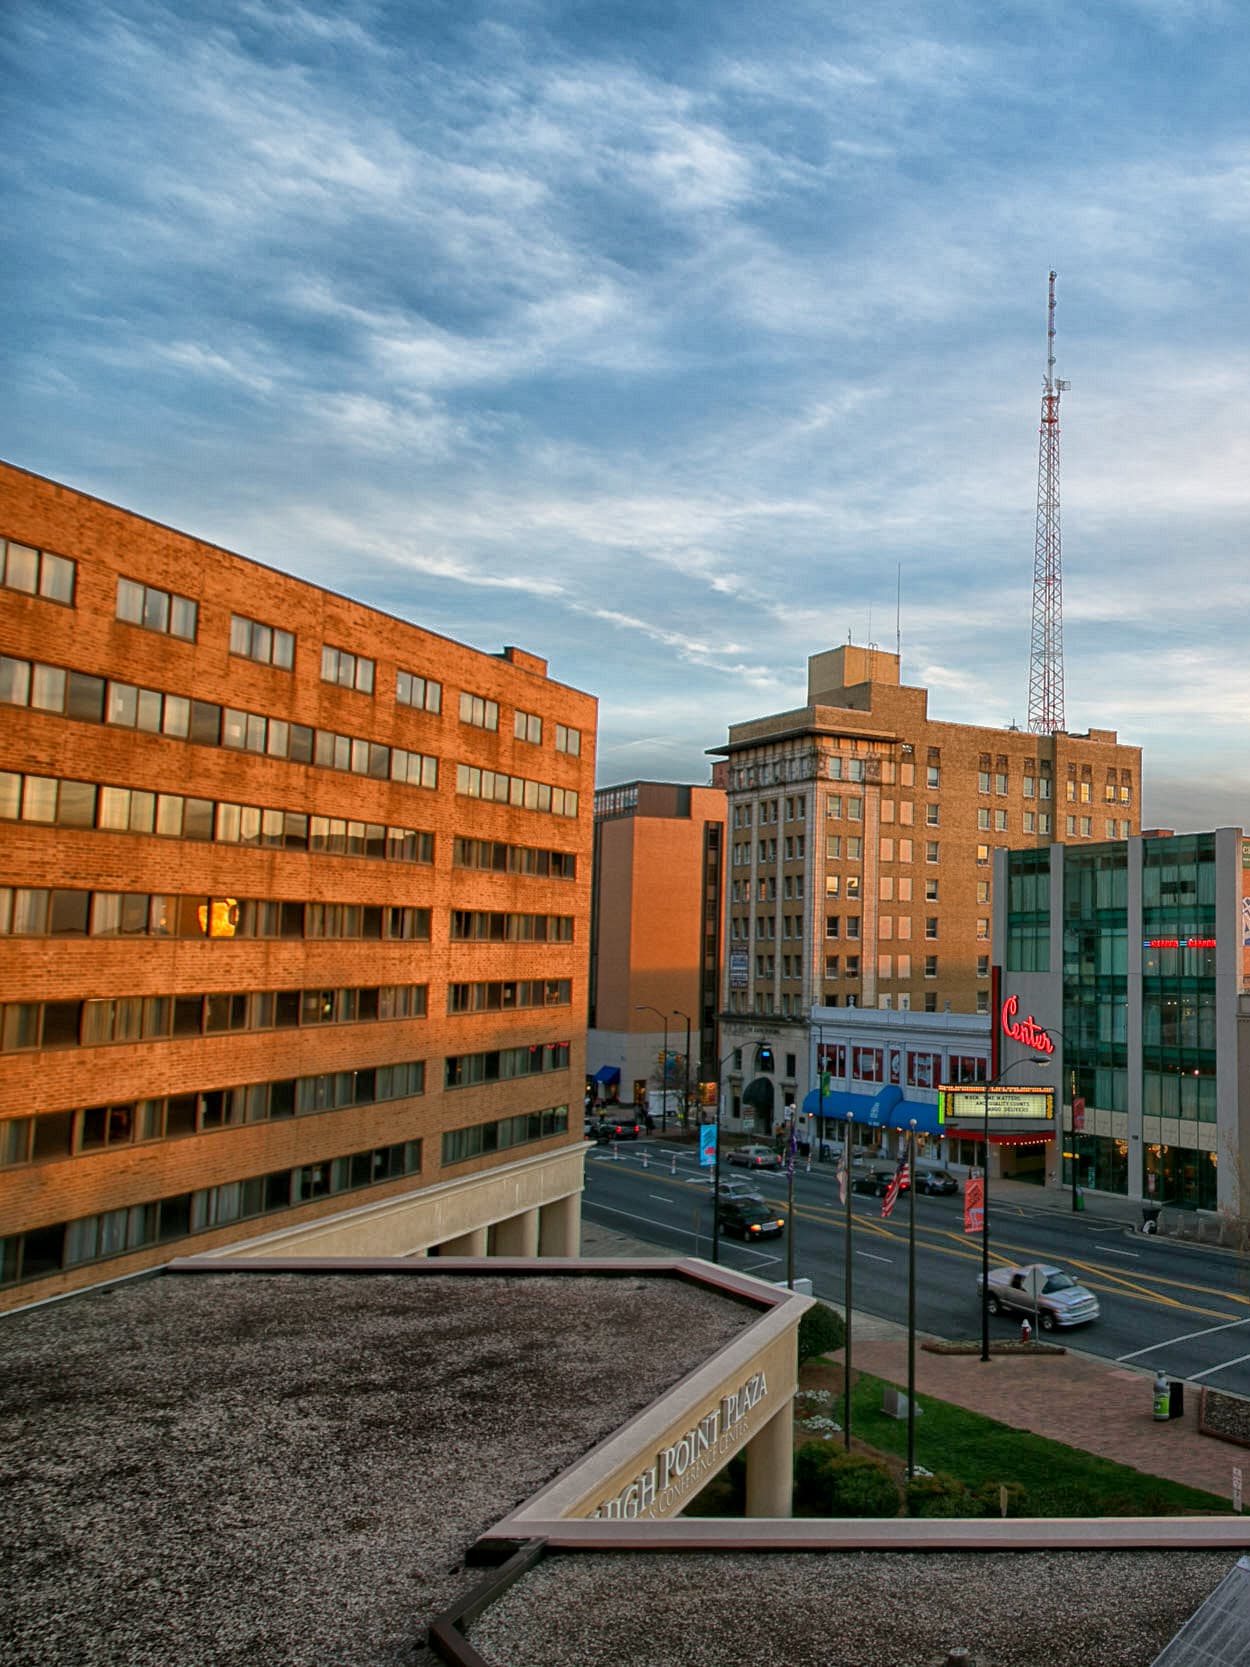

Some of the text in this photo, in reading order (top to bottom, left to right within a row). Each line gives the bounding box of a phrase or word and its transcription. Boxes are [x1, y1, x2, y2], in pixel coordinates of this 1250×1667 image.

[1001, 995, 1054, 1054] Center
[659, 1409, 721, 1488] POINT
[724, 1371, 768, 1430] PLAZA
[659, 1418, 749, 1513] CONFERENCE CENTER
